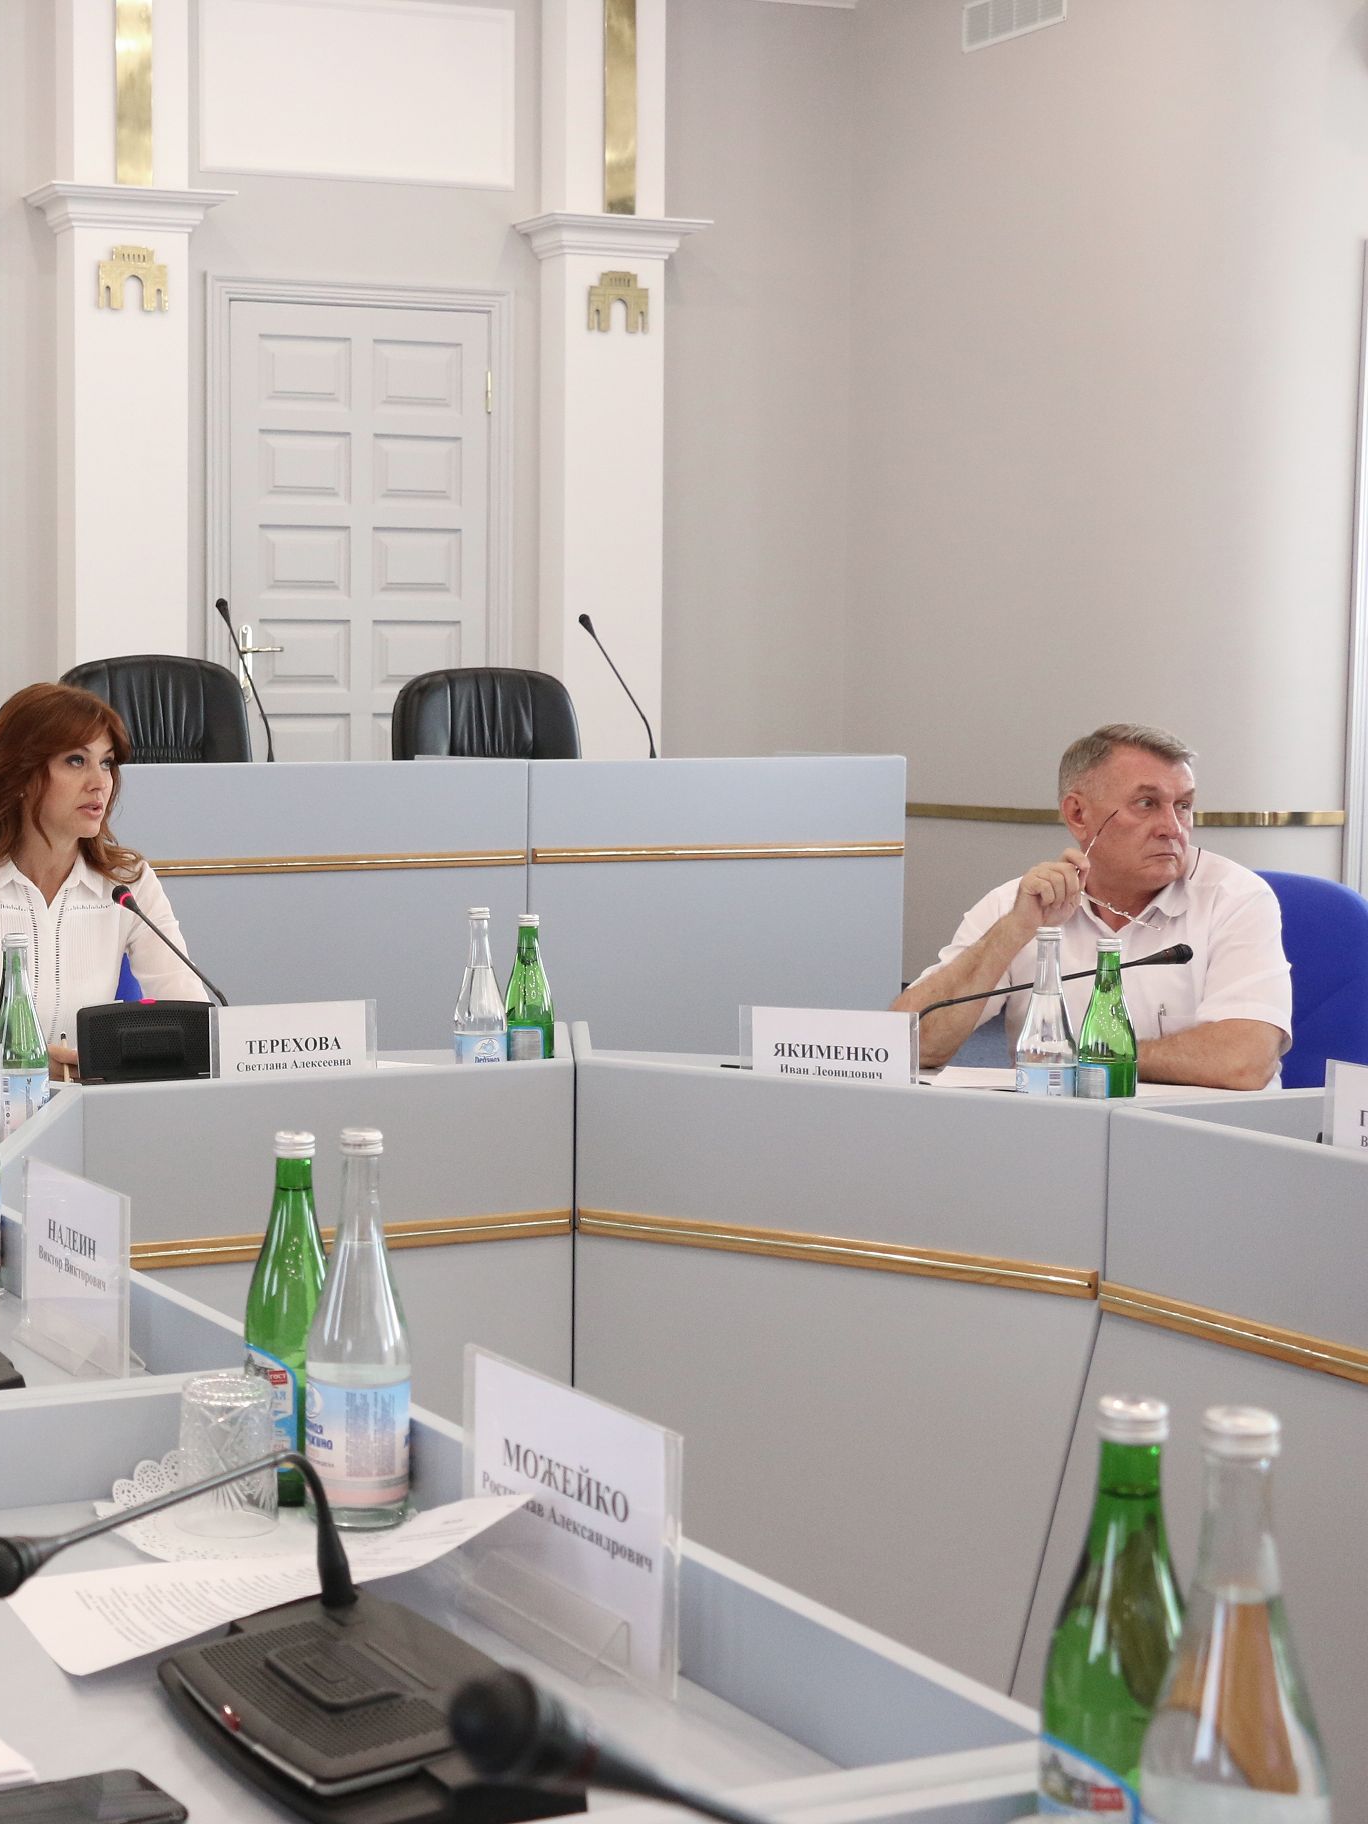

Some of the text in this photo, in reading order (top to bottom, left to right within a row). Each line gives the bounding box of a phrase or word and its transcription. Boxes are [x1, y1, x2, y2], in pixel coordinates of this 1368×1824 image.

[245, 1036, 342, 1055] ТЕРЕХОВА
[773, 1042, 890, 1063] ЯКИМЕНКО
[236, 1057, 352, 1073] Светлана Алексеевна
[780, 1063, 883, 1080] Иван Леонидович
[48, 1218, 97, 1262] НАДЕИН
[38, 1244, 107, 1292] Виктор Викторович
[503, 1438, 630, 1523] МОЖЕЙКО
[549, 1505, 653, 1574] Александрович
